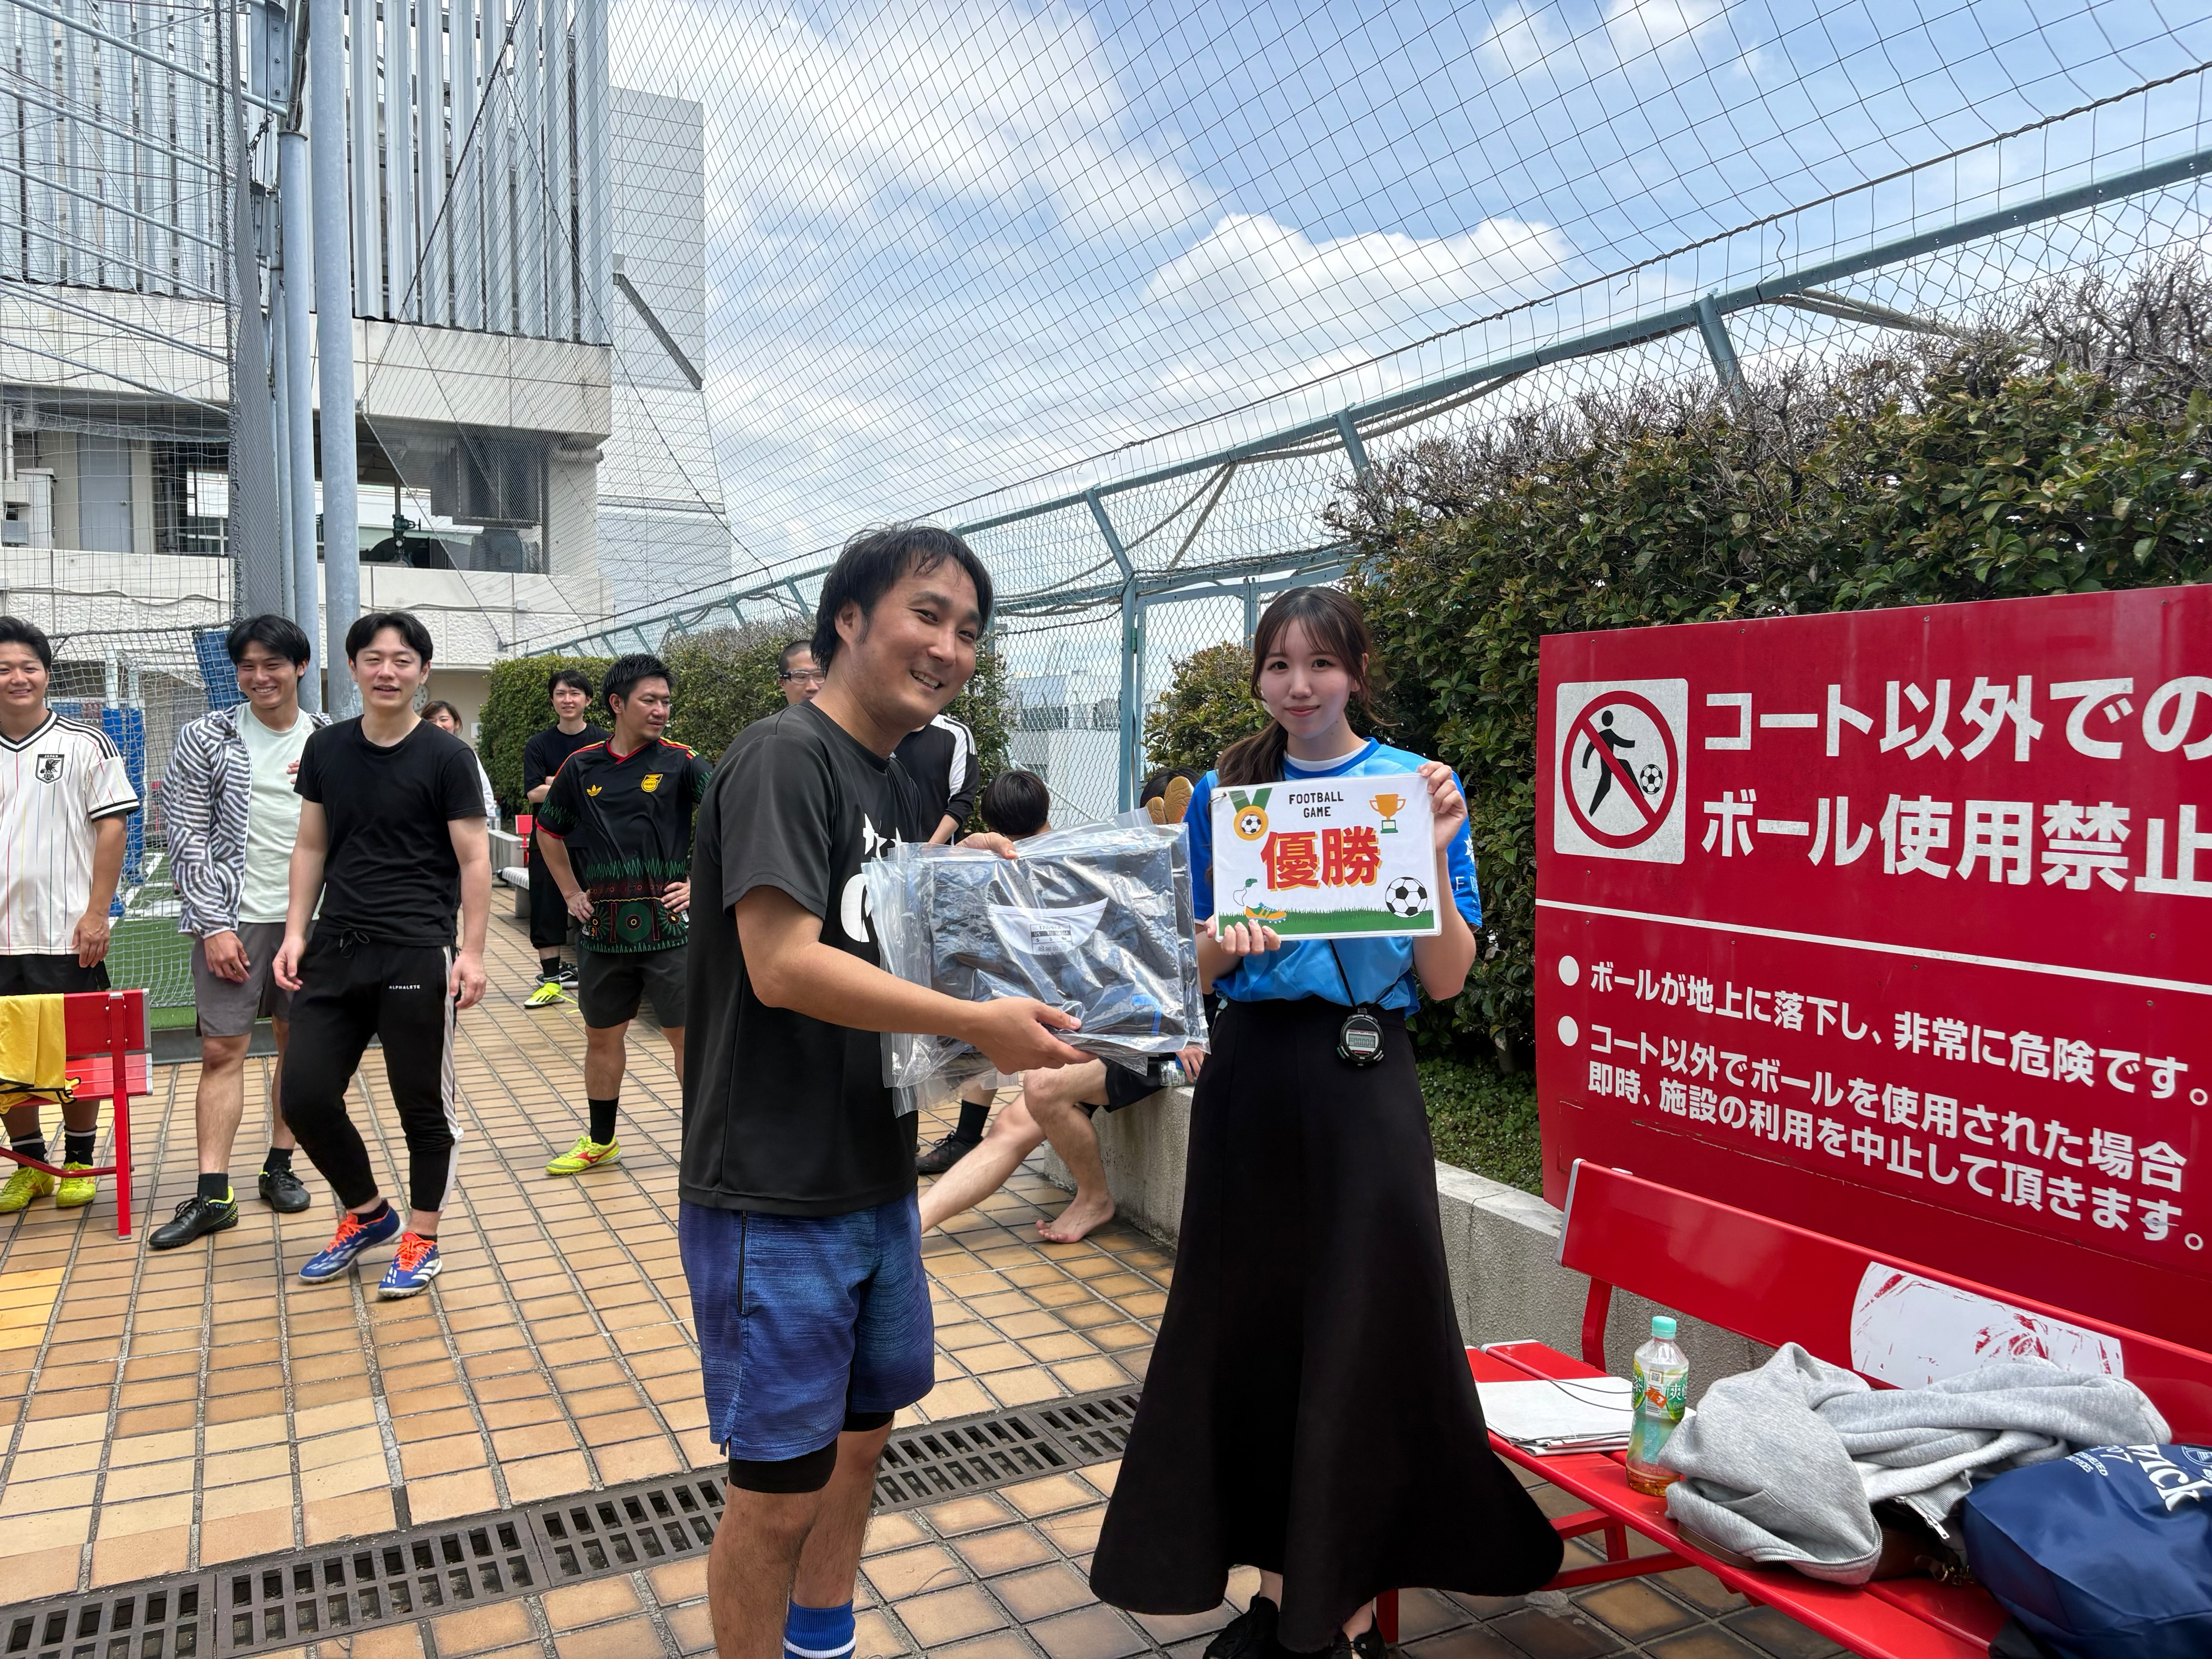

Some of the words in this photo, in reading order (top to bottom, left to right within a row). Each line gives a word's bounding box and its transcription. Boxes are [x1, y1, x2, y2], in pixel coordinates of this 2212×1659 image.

[1705, 676, 2212, 762] コート以外での
[1289, 791, 1344, 805] FOOTBALL
[1304, 806, 1331, 818] GAME
[1701, 788, 2212, 898] ボール使用禁止
[1260, 826, 1382, 891] 優勝
[1590, 961, 2209, 1106] ボールが地上に落下し、非常に危険です。
[1588, 1060, 2204, 1251] 即時、施設の利用を中止して頂きます。
[1591, 1024, 2187, 1192] コート以外でボールを使用された場合
